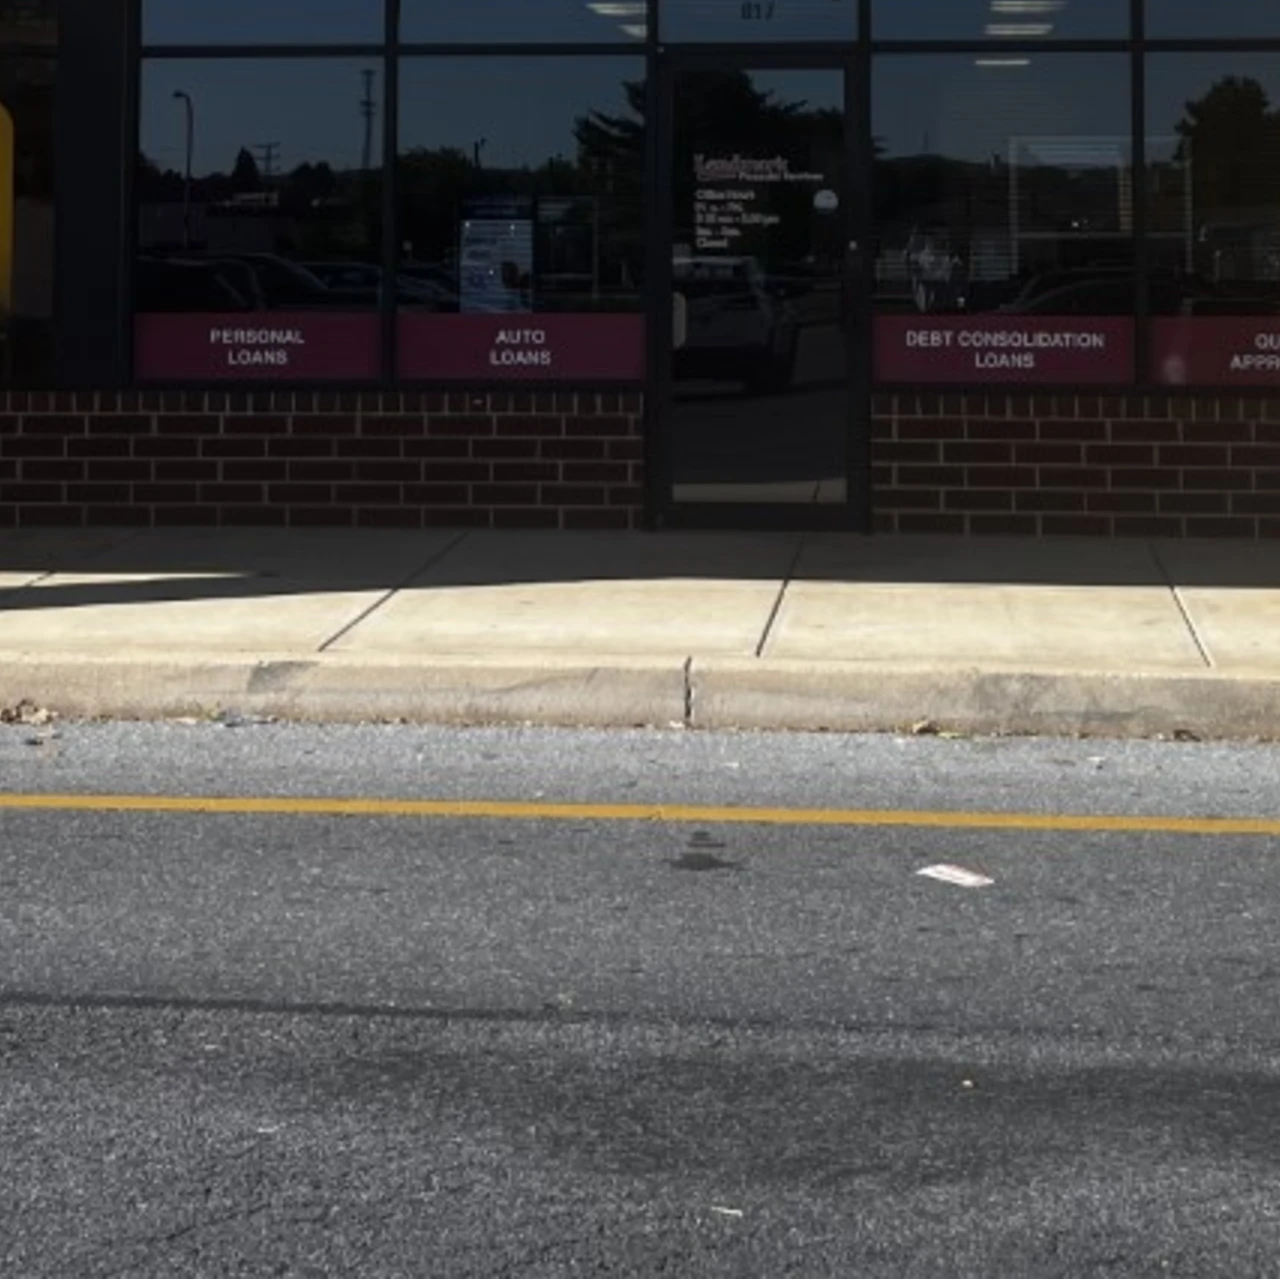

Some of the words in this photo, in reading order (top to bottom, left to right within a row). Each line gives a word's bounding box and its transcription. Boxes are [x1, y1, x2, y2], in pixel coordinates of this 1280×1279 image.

[210, 327, 306, 344] PERSONAL
[495, 329, 546, 344] AUTO
[906, 330, 955, 347] DEBT
[957, 331, 1105, 348] CONSOLIDATION
[227, 348, 288, 365] LOANS
[489, 348, 552, 366] LOANS
[975, 351, 1036, 368] LOANS
